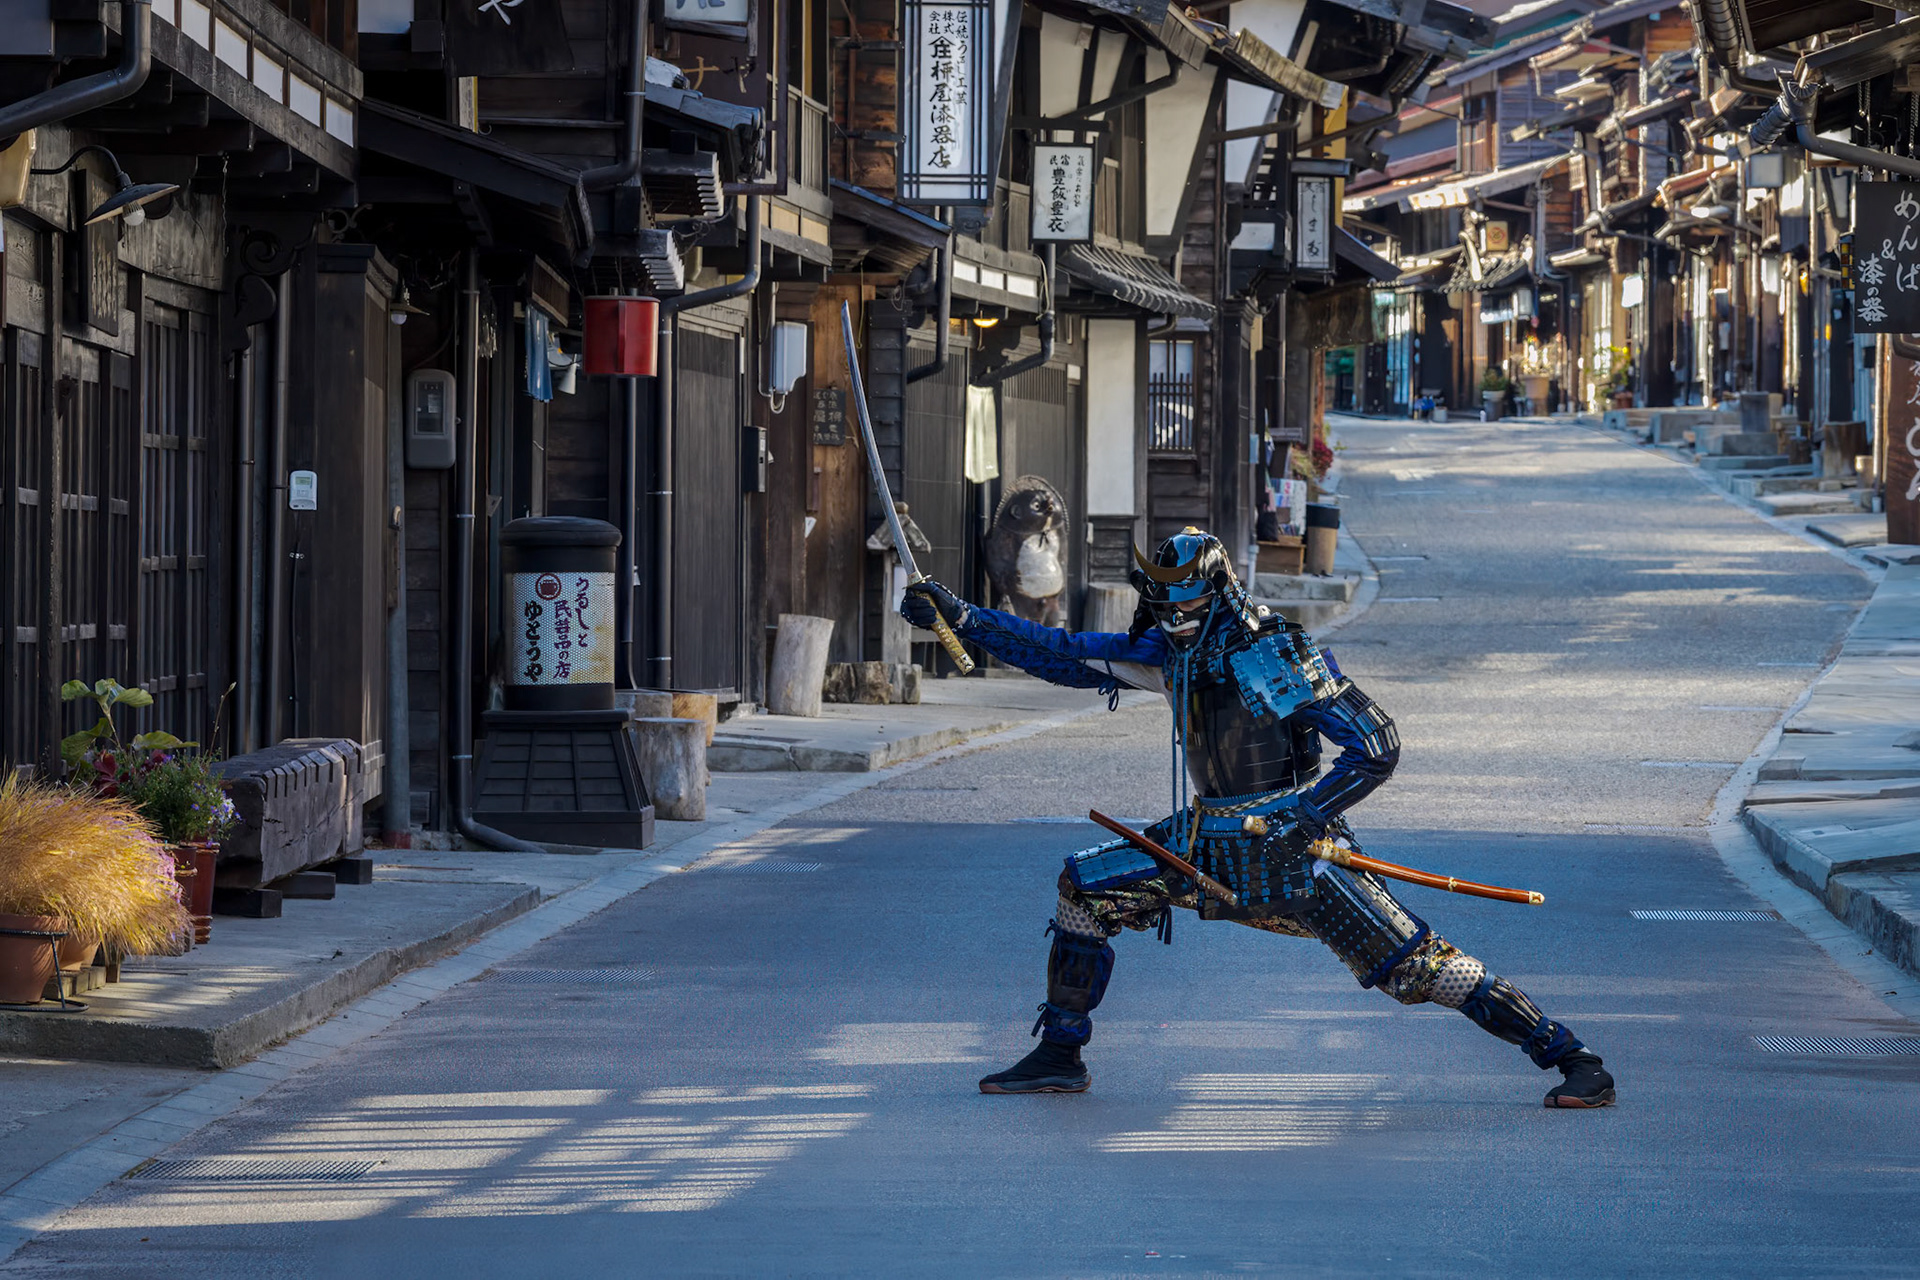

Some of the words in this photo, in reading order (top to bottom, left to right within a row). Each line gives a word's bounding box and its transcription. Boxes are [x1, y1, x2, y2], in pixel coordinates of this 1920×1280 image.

[928, 10, 941, 35] 会社
[942, 10, 955, 35] 株式
[1881, 238, 1896, 261] &
[1894, 190, 1920, 292] めんぱ
[1857, 252, 1888, 323] 漆の器
[575, 577, 589, 648] うるしと
